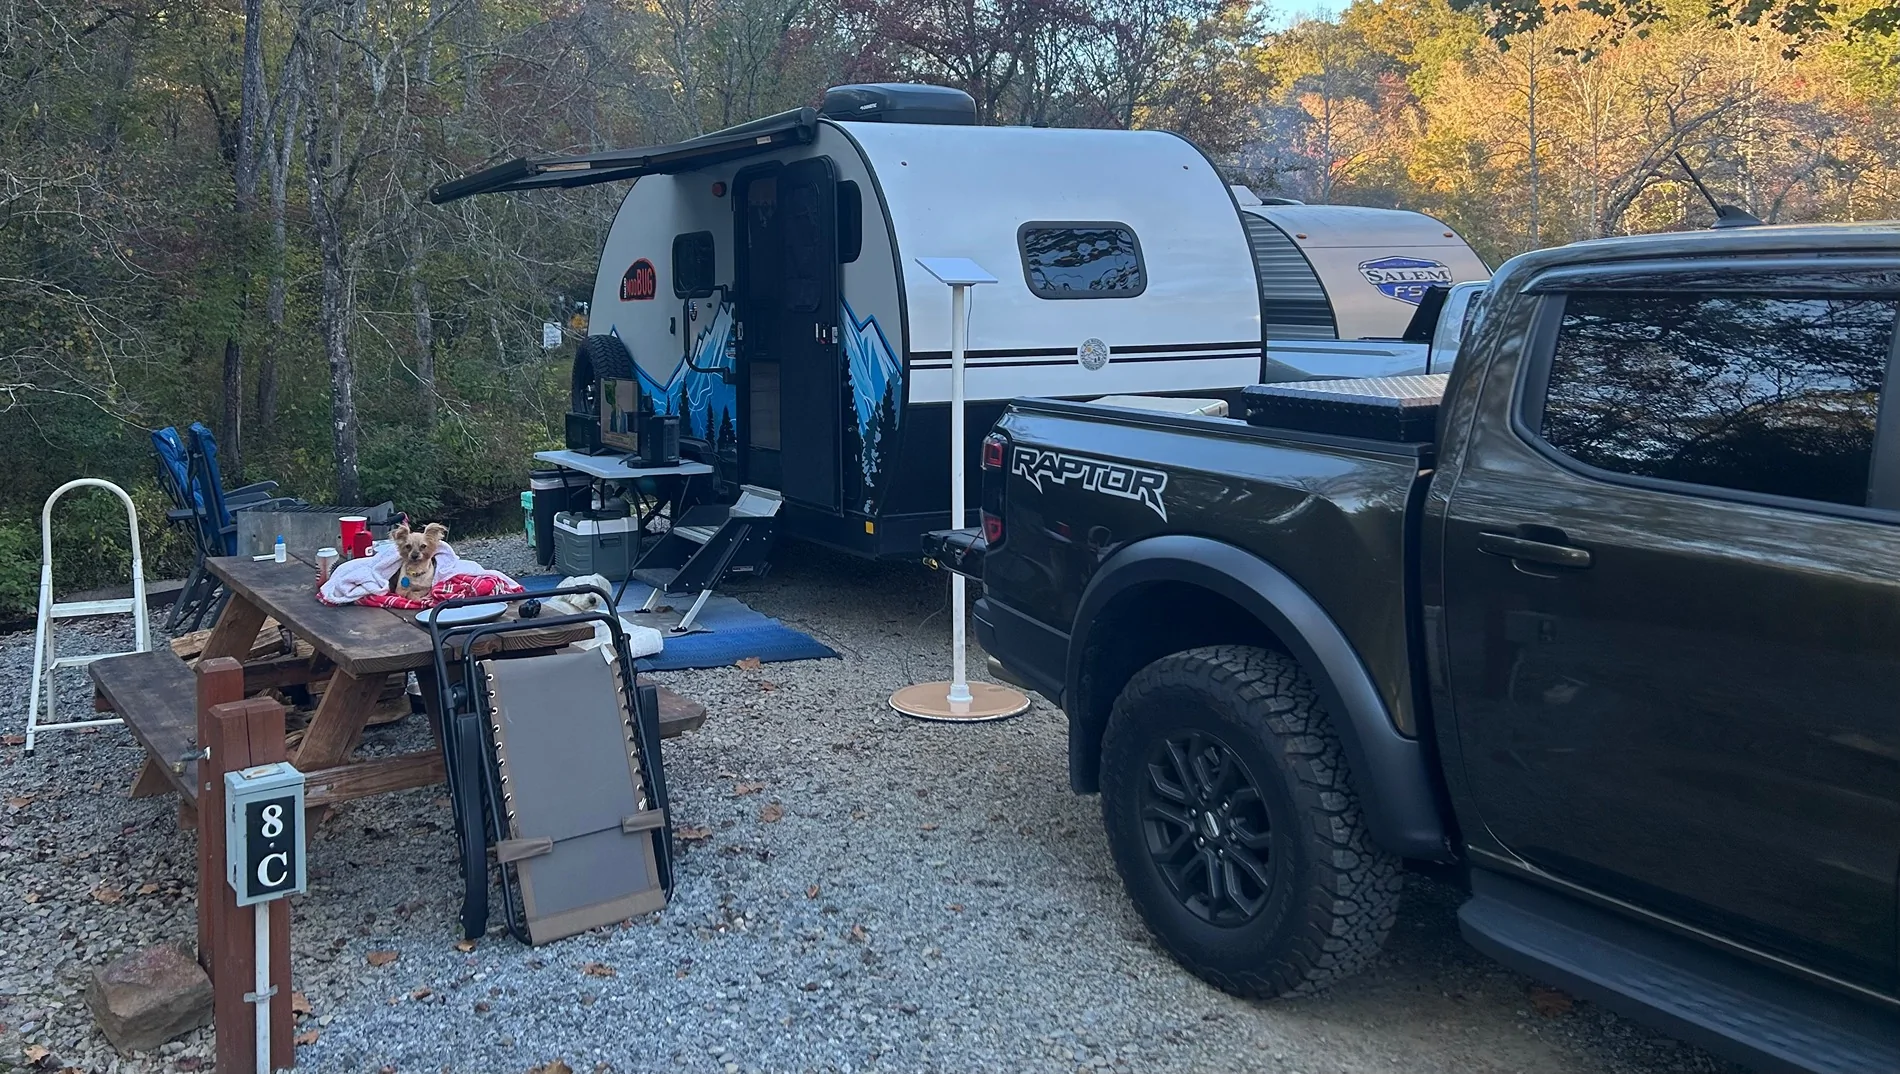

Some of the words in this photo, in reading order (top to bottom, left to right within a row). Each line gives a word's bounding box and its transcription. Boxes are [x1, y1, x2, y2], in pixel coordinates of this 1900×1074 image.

[1365, 270, 1450, 282] SALEM
[1012, 446, 1168, 523] RAPTOR
[261, 804, 284, 838] 8
[257, 851, 288, 887] C
